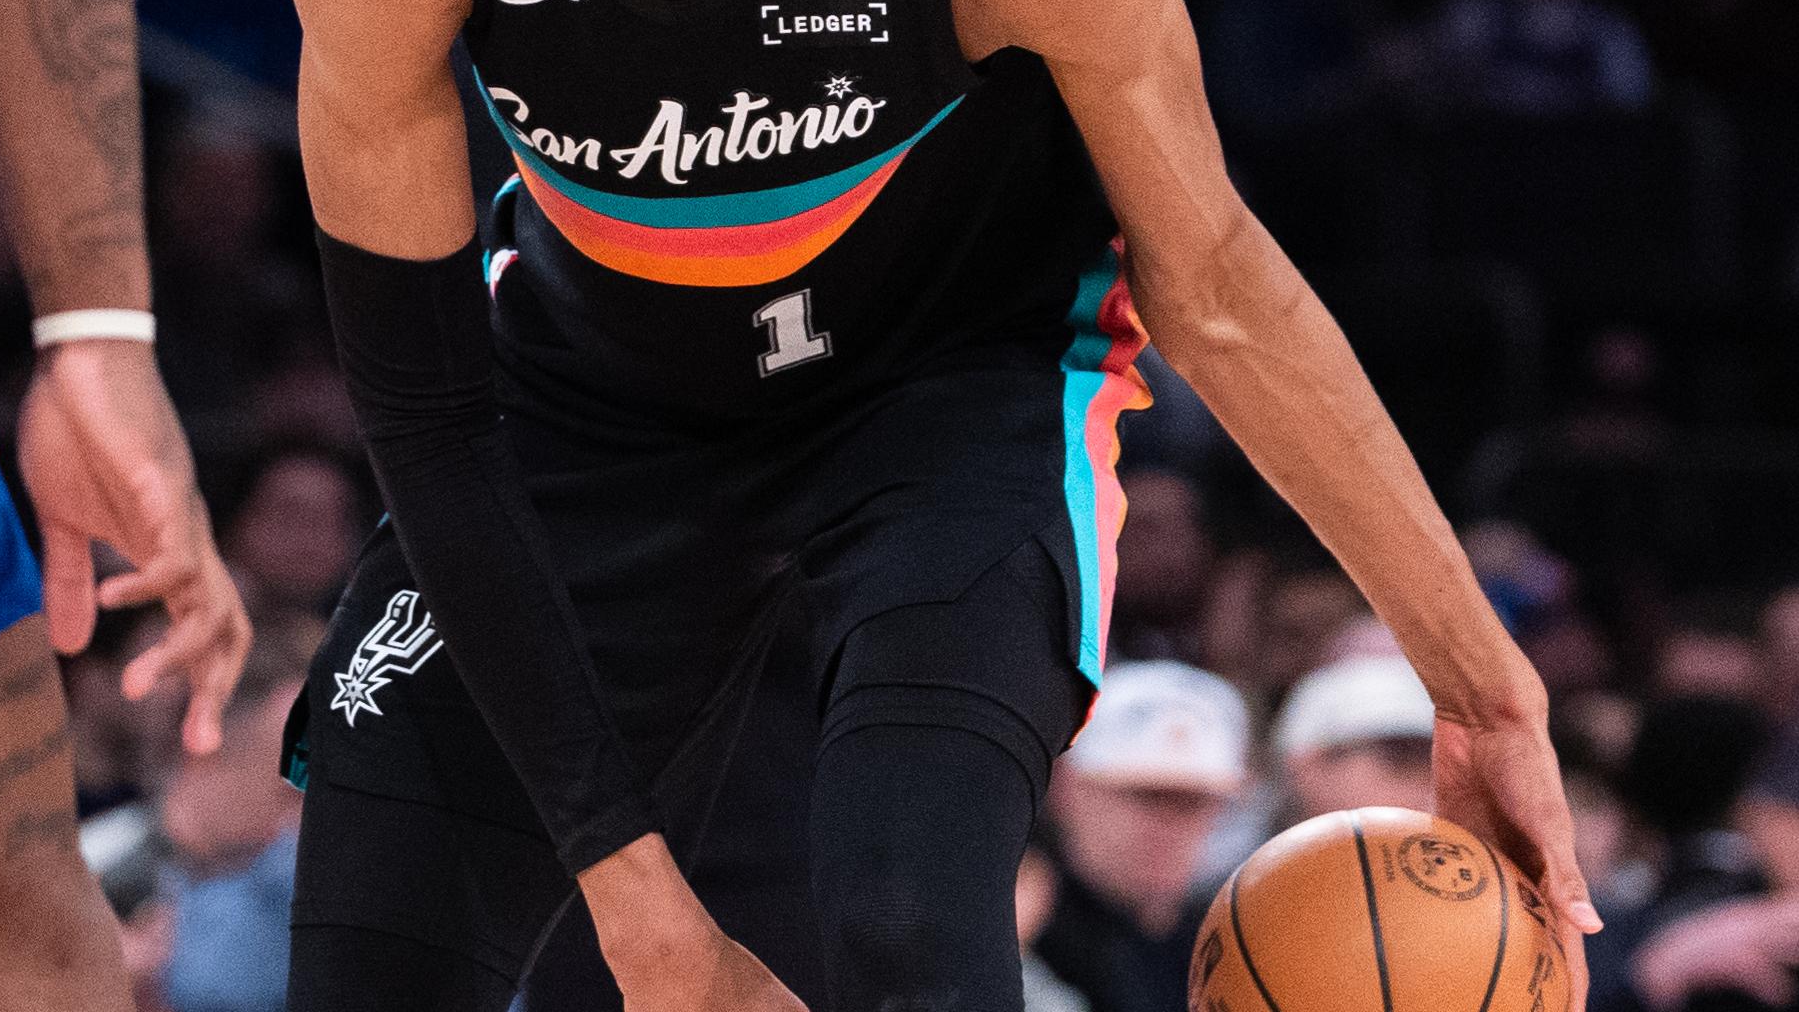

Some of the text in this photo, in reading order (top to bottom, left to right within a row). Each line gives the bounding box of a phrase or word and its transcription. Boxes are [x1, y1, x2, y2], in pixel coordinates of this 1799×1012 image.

[777, 13, 873, 35] LEDGER
[609, 74, 887, 186] Antonio
[751, 287, 835, 379] 1
